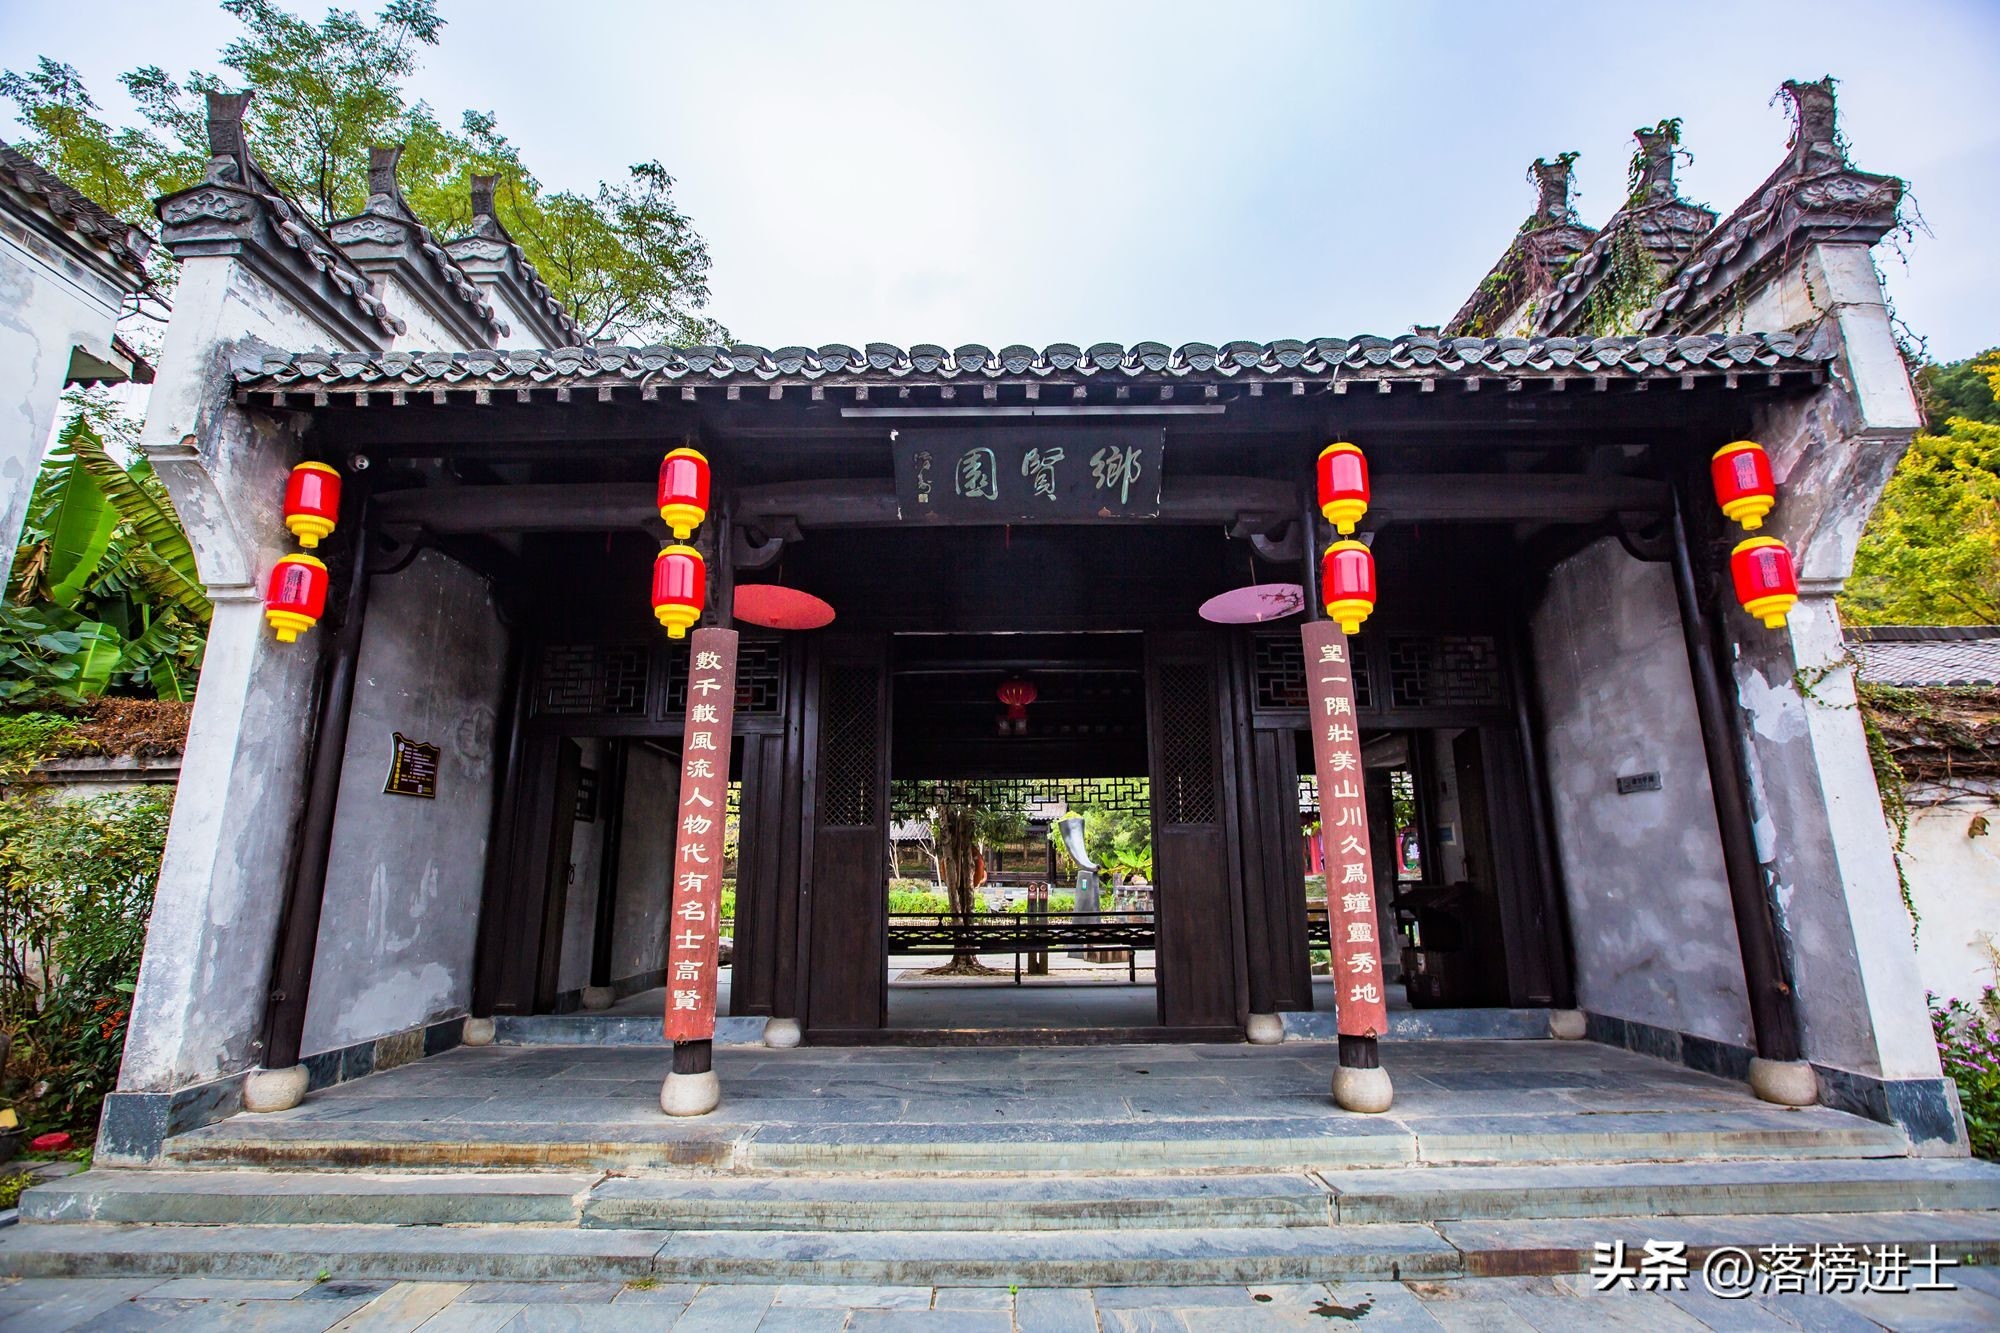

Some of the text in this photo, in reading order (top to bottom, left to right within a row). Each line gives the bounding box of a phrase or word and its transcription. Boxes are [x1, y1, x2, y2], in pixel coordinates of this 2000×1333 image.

[672, 651, 723, 1011] 數千載風流人物代有名士高賢
